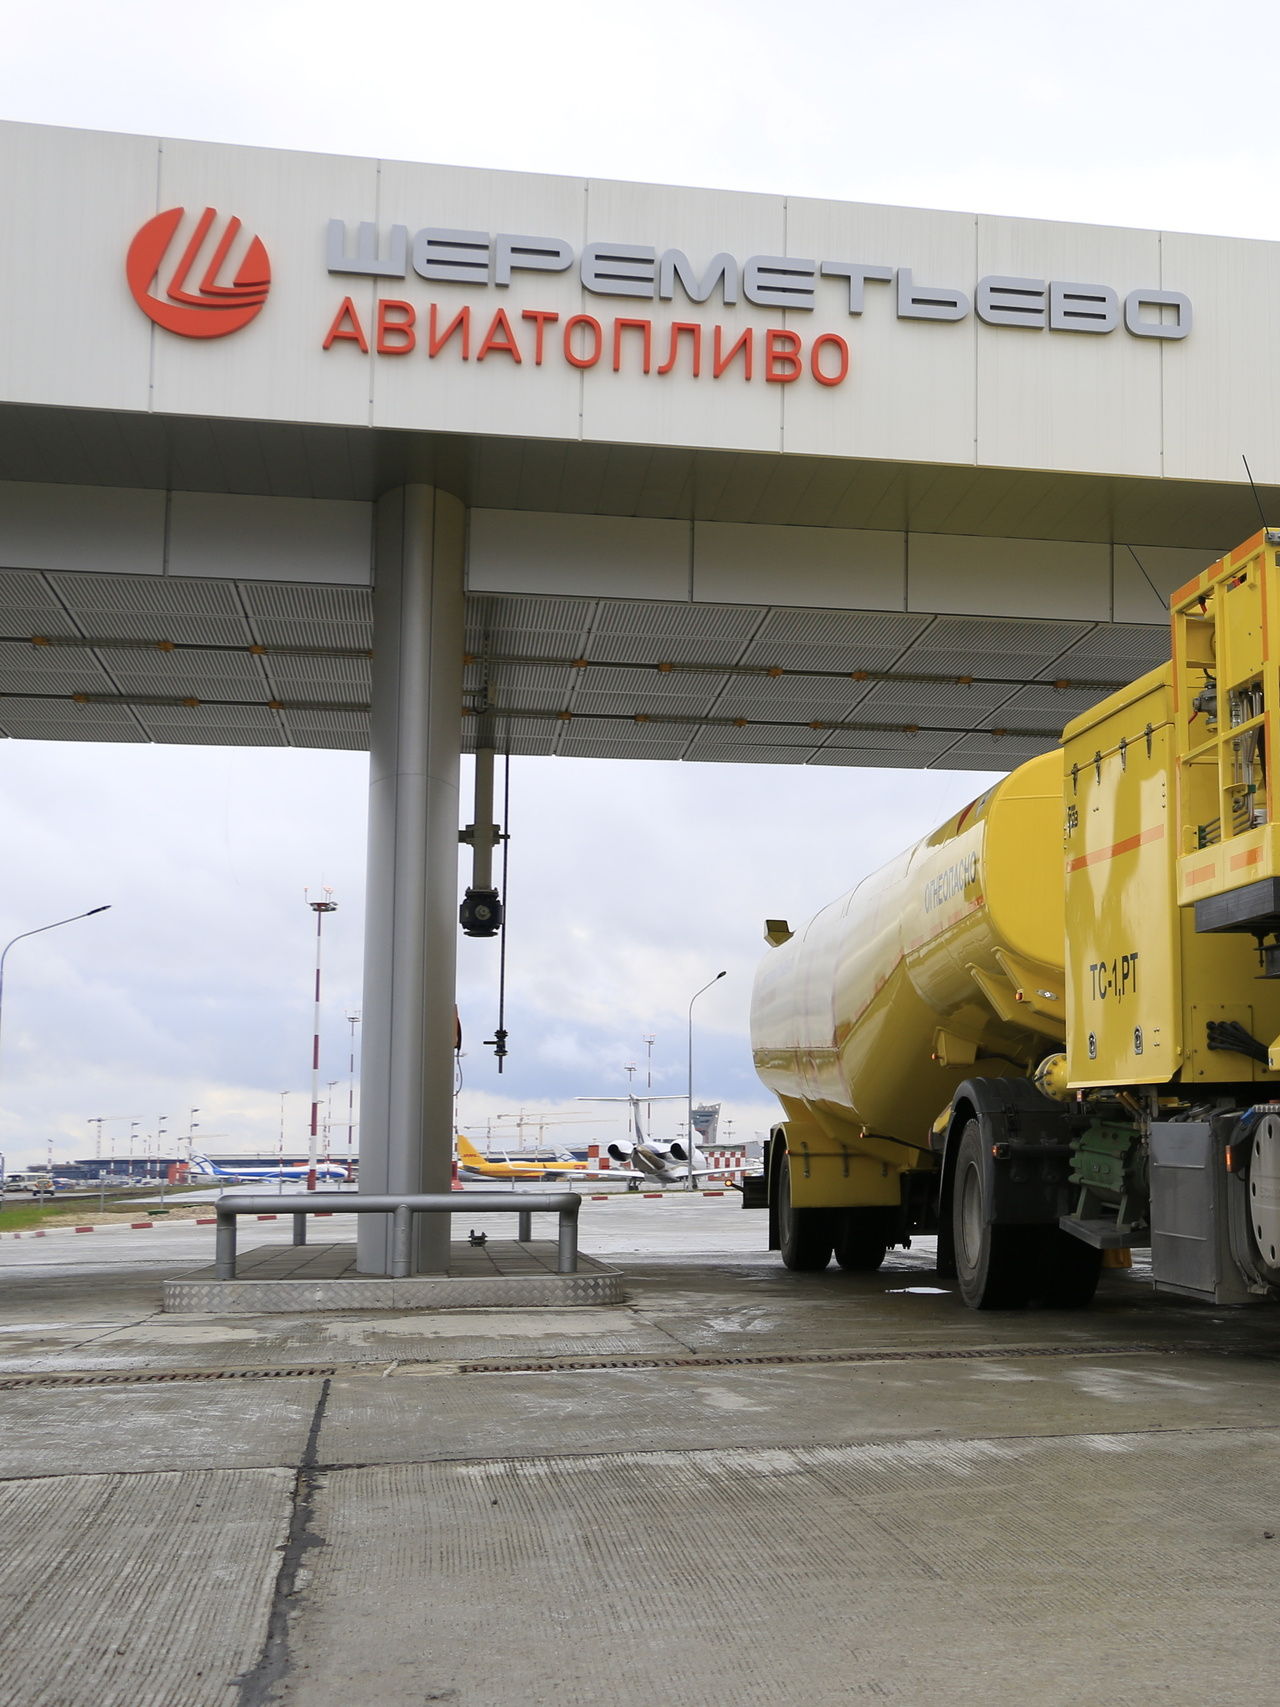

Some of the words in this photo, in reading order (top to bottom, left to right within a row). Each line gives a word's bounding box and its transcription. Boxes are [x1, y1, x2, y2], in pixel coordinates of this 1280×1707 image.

[327, 219, 1192, 341] ШЕРЕМЕТЬЕВО
[323, 296, 849, 387] АВИАТОПЛИВО
[925, 851, 977, 914] ОГНЕОПАСНО
